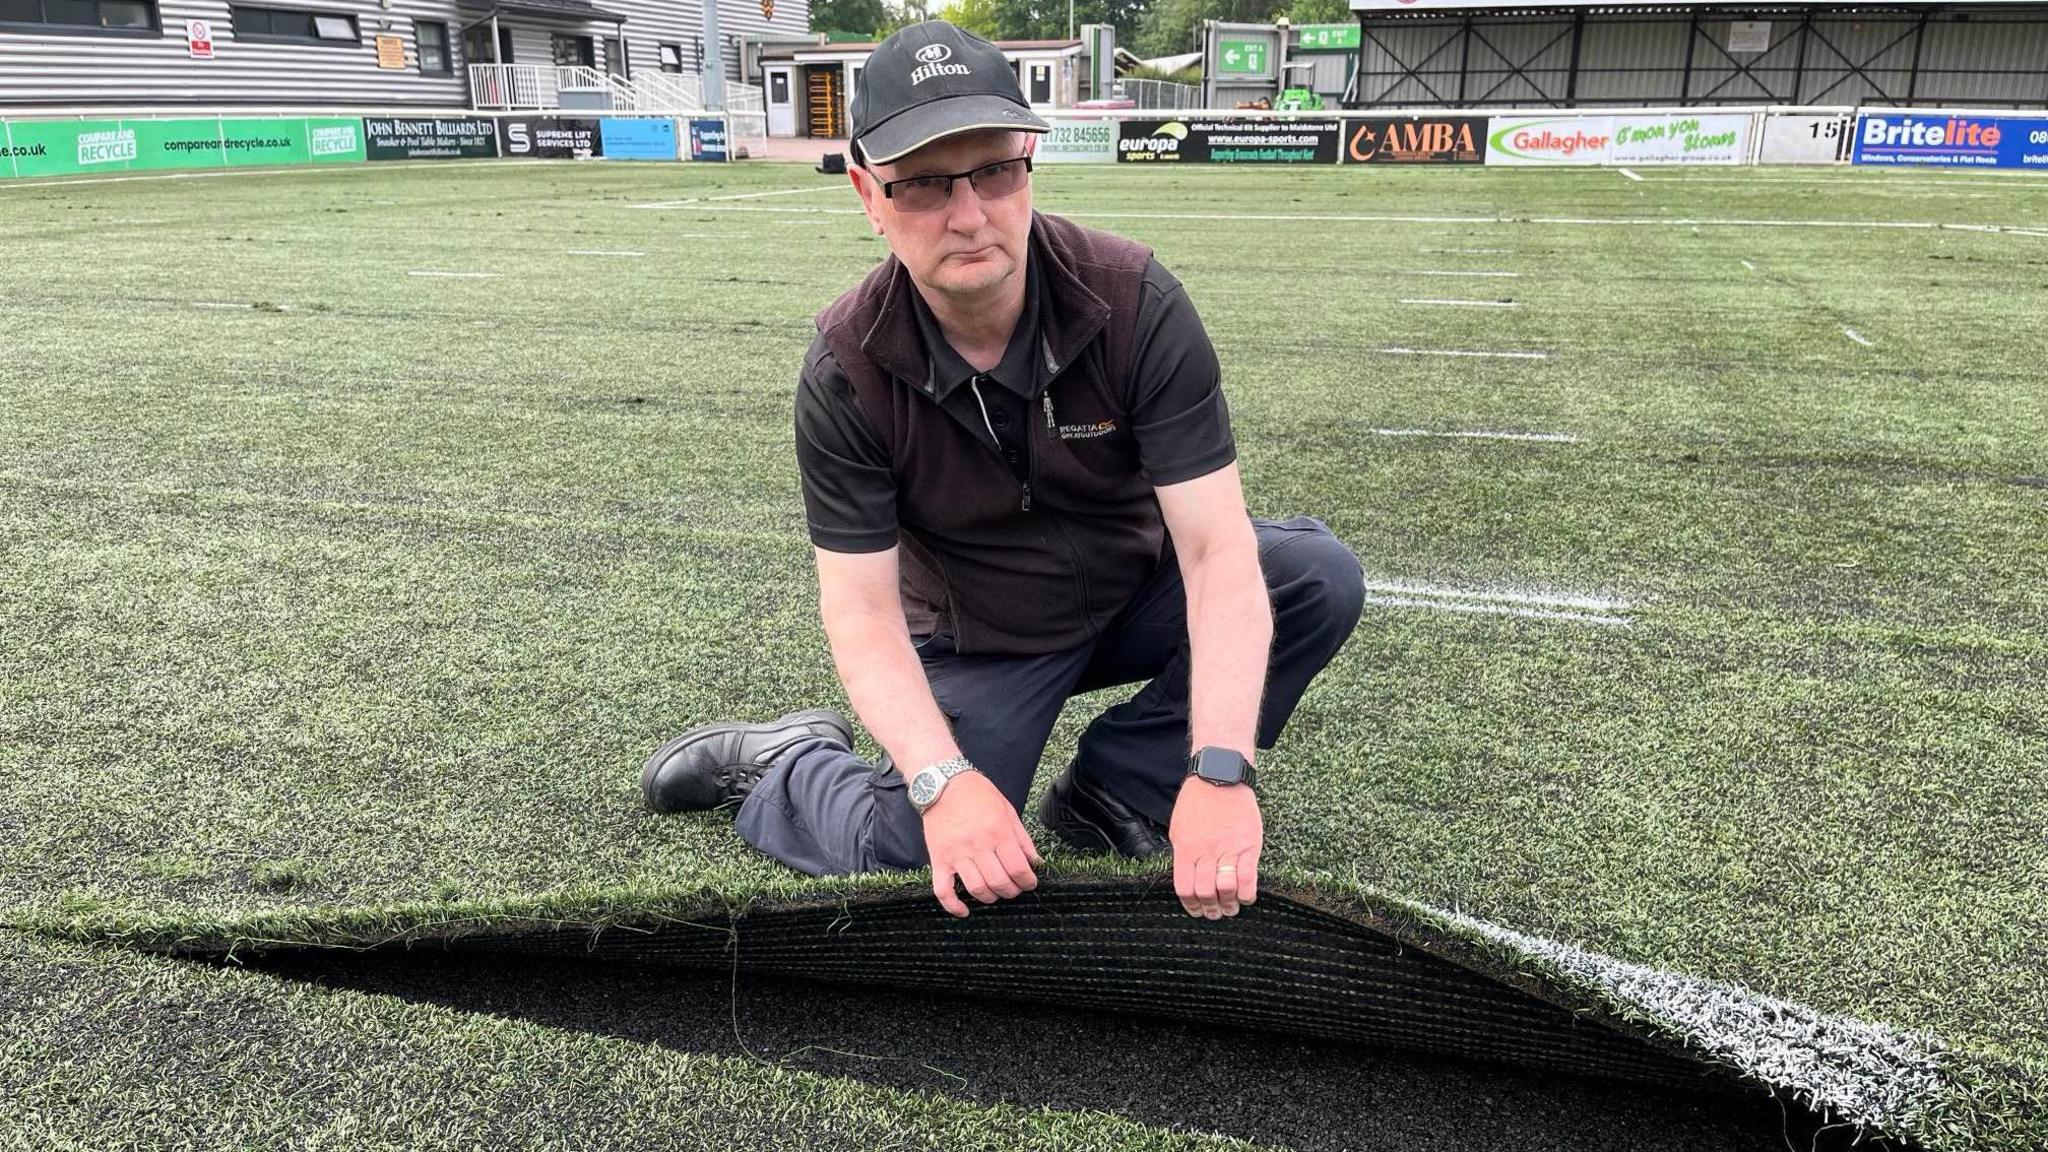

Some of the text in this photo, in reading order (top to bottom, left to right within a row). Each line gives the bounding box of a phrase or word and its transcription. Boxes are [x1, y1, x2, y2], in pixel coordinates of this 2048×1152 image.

[910, 62, 972, 86] Hilton
[366, 119, 493, 139] JOHN BENNETT BILLIARDS LTD
[535, 130, 592, 139] SUPREME LIFT
[1041, 127, 1110, 143] 01732 845656
[1191, 123, 1214, 132] Official
[1215, 123, 1243, 132] Technical
[1254, 123, 1280, 133] Supplier
[1289, 123, 1324, 132] Maidstone
[1862, 117, 2001, 147] Britelite
[78, 129, 135, 144] COMPARE AND
[536, 139, 591, 148] SERVICES LTD
[1208, 134, 1318, 145] www.europa-sports.com
[1378, 123, 1476, 153] AMBA
[1513, 131, 1610, 155] Gallagher
[2029, 130, 2048, 144] 08
[0, 143, 47, 157] e.co.uk
[81, 142, 134, 161] RECYCLE
[164, 137, 292, 153] compareandrecycle.co.uk
[315, 137, 354, 152] RECYCLE
[1119, 137, 1178, 154] europa
[1126, 152, 1155, 162] sports
[1861, 154, 1896, 163] Windows,
[1897, 155, 1951, 163] Conservatories
[1059, 423, 1098, 435] REGATTA
